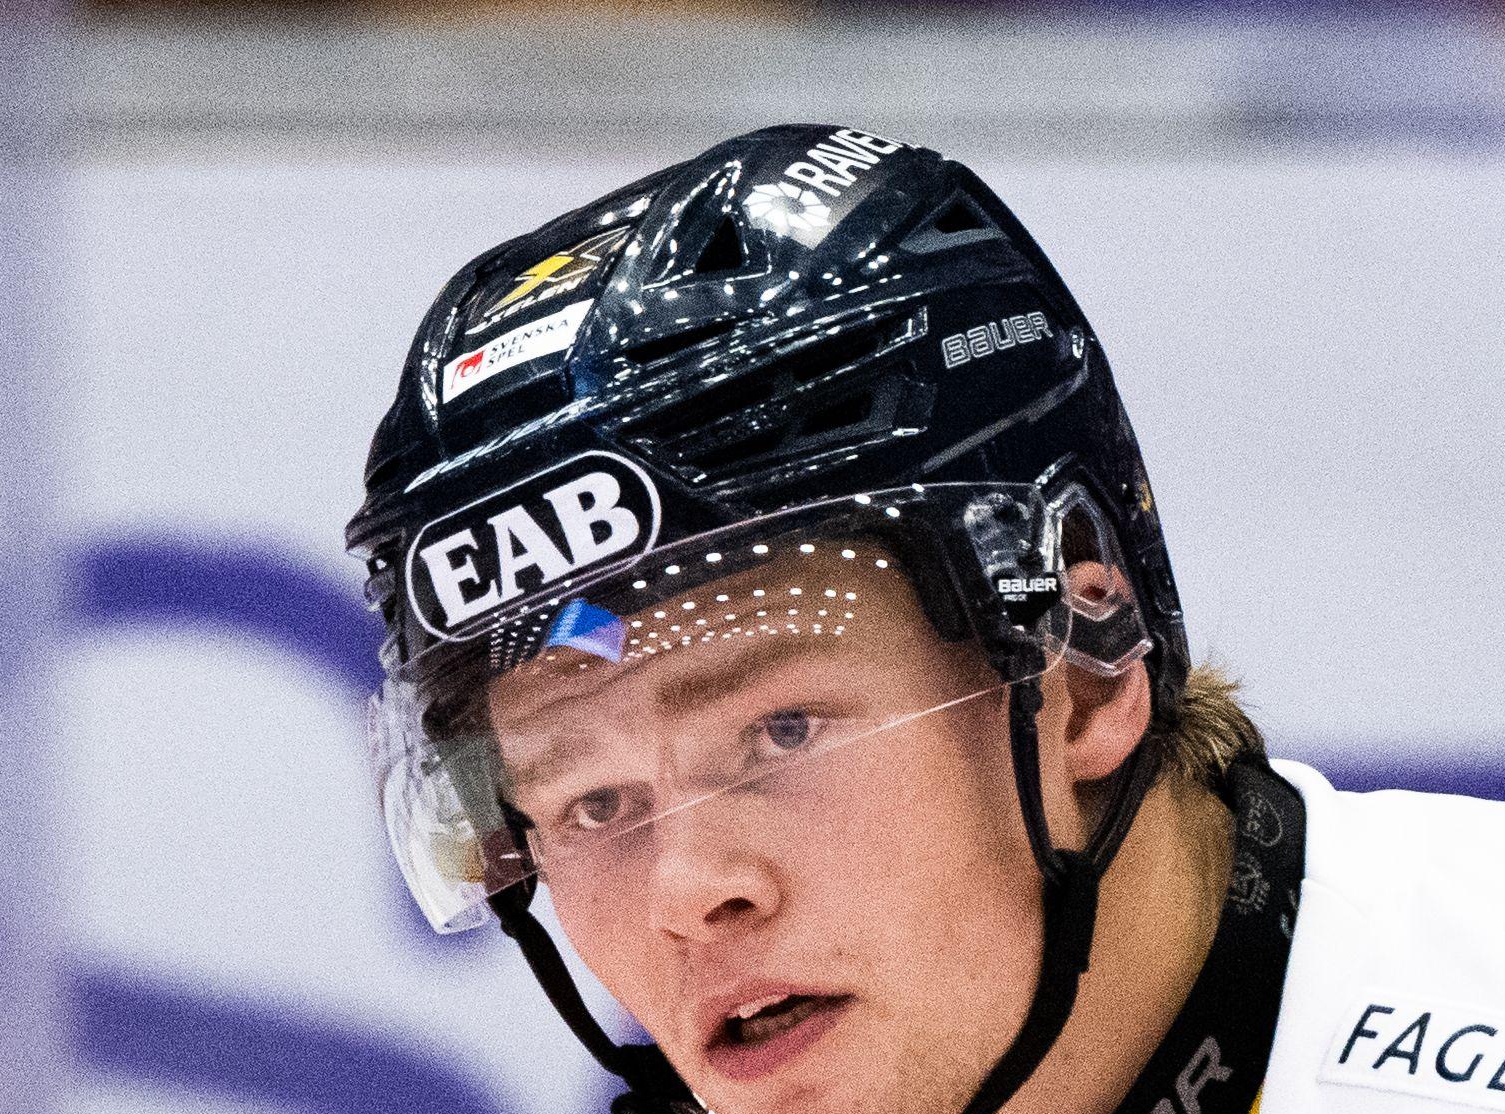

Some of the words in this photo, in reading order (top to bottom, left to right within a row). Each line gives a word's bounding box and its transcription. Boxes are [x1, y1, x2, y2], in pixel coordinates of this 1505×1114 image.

[491, 318, 570, 354] SVENSKA
[941, 311, 1054, 369] BAUER
[419, 471, 640, 628] EAB
[998, 577, 1057, 593] BAUER
